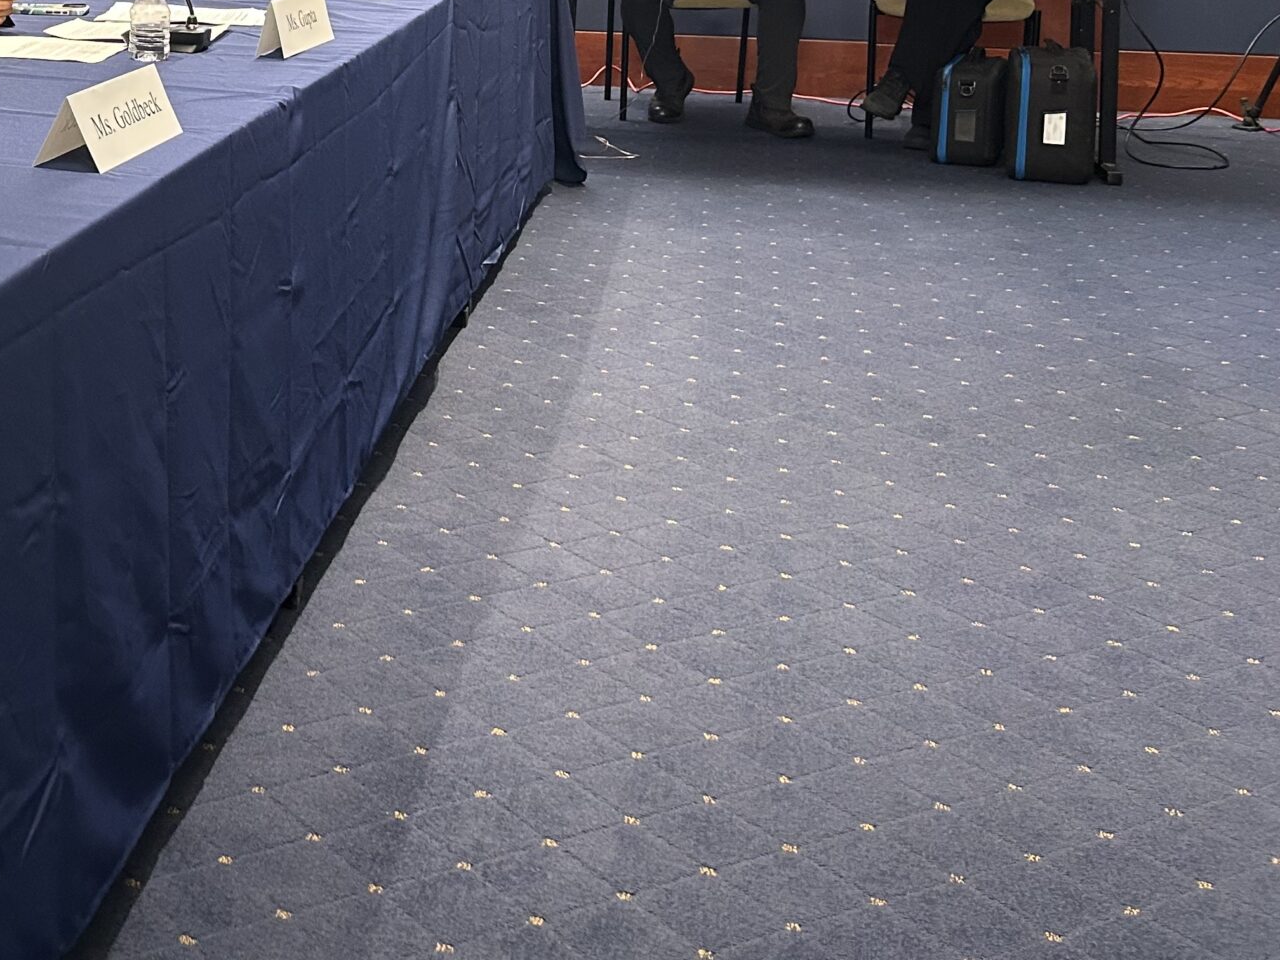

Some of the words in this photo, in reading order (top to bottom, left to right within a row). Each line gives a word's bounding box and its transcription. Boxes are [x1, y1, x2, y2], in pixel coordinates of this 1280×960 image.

[298, 10, 318, 29] Gupta
[90, 113, 116, 139] Ms.
[113, 92, 163, 129] Goldbeck
